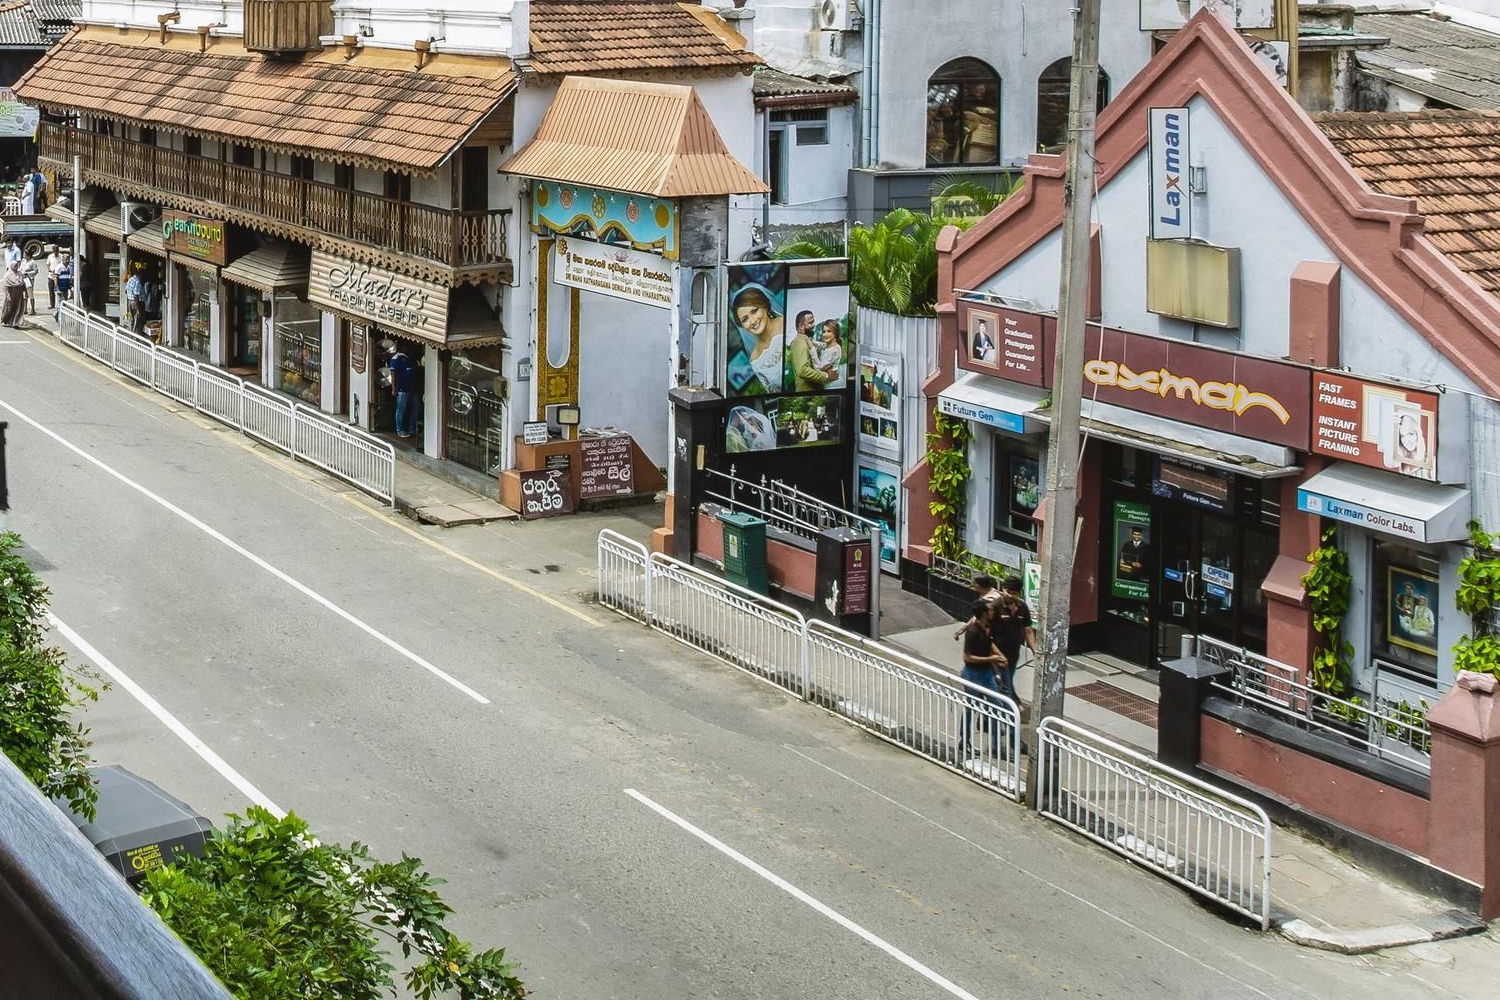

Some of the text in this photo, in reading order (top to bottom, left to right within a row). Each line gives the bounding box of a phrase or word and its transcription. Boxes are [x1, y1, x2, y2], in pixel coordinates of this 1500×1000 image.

[1160, 113, 1187, 226] Laxman
[174, 218, 221, 242] earthbound
[329, 288, 376, 311] TRADING
[379, 304, 428, 326] AGENCY
[1005, 317, 1018, 326] Your
[1004, 328, 1033, 339] Graduation
[1004, 338, 1035, 351] Photograph
[1004, 350, 1035, 362] Guaranteed
[1005, 360, 1015, 368] For
[1084, 360, 1290, 425] axman
[1319, 382, 1343, 394] FAST
[1319, 394, 1357, 409] FRAMES
[952, 403, 994, 421] Future Gen
[1318, 415, 1357, 431] INSTANT
[1318, 427, 1358, 443] PICTURE
[1318, 439, 1360, 456] FRAMING
[1327, 501, 1416, 534] Laxman Color Labs.
[1207, 566, 1229, 580] OPEN
